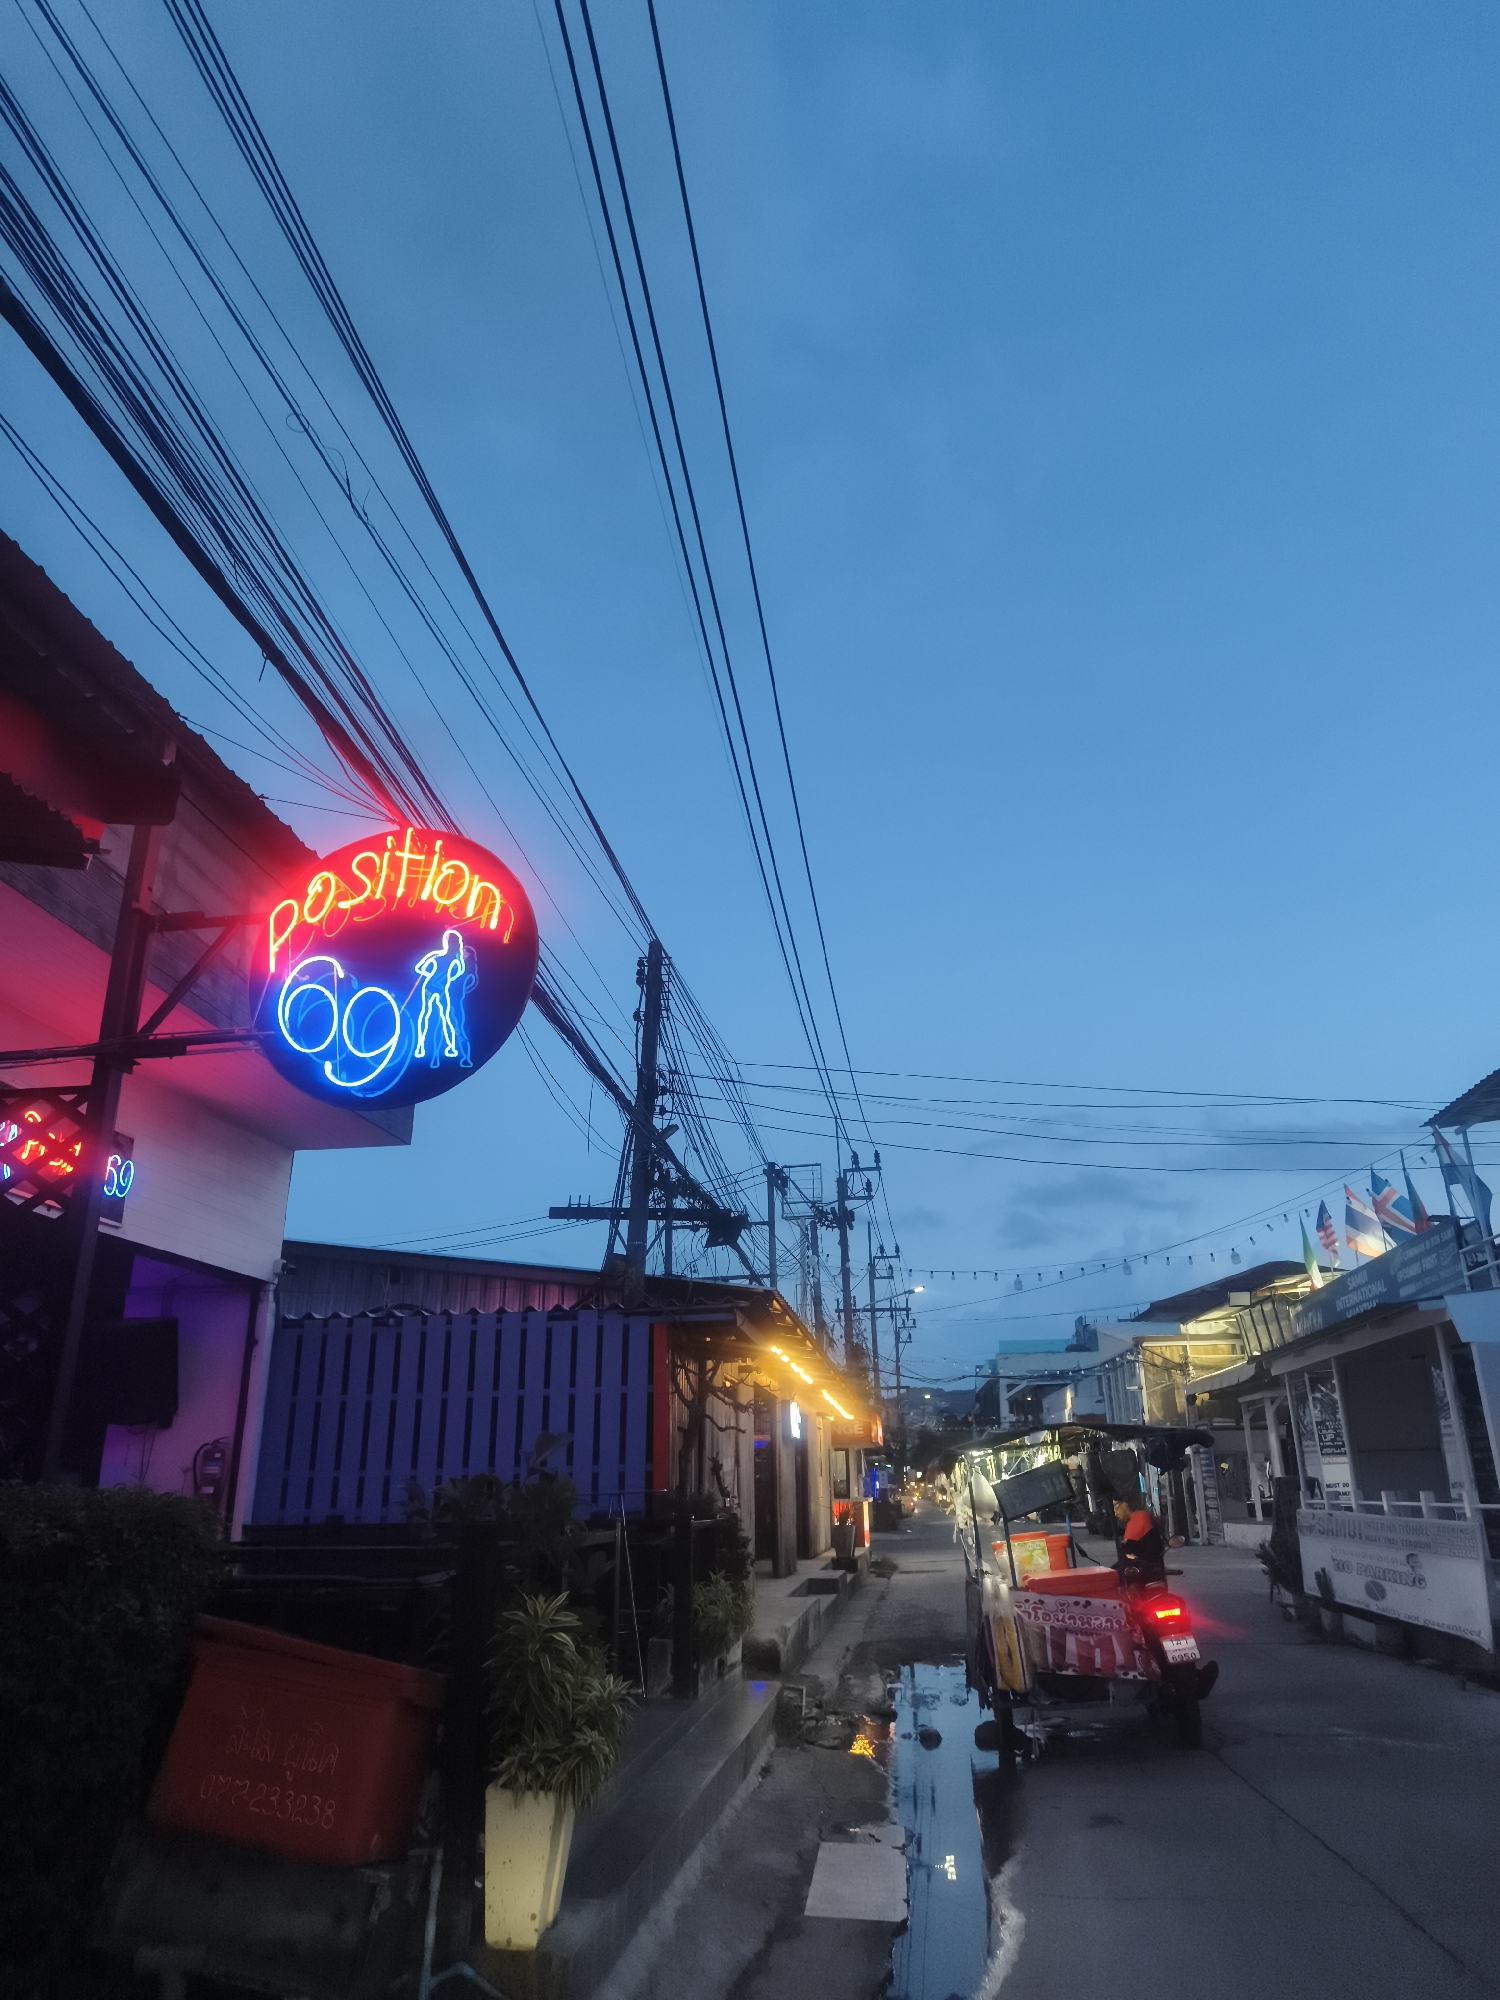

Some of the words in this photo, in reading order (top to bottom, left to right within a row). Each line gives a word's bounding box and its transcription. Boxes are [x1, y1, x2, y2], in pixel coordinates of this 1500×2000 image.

[277, 955, 401, 1087] 69
[1347, 1270, 1369, 1290] SAMUI
[1335, 1279, 1388, 1312] INTERNATIONAL
[1317, 1516, 1363, 1541] SAMUI
[1363, 1518, 1431, 1537] INTERNATIONAL
[1400, 1539, 1432, 1550] STADIUM
[1332, 1560, 1354, 1574] NO
[1356, 1561, 1427, 1589] PARKING
[1403, 1612, 1421, 1622] not
[1423, 1617, 1482, 1638] guaranteed
